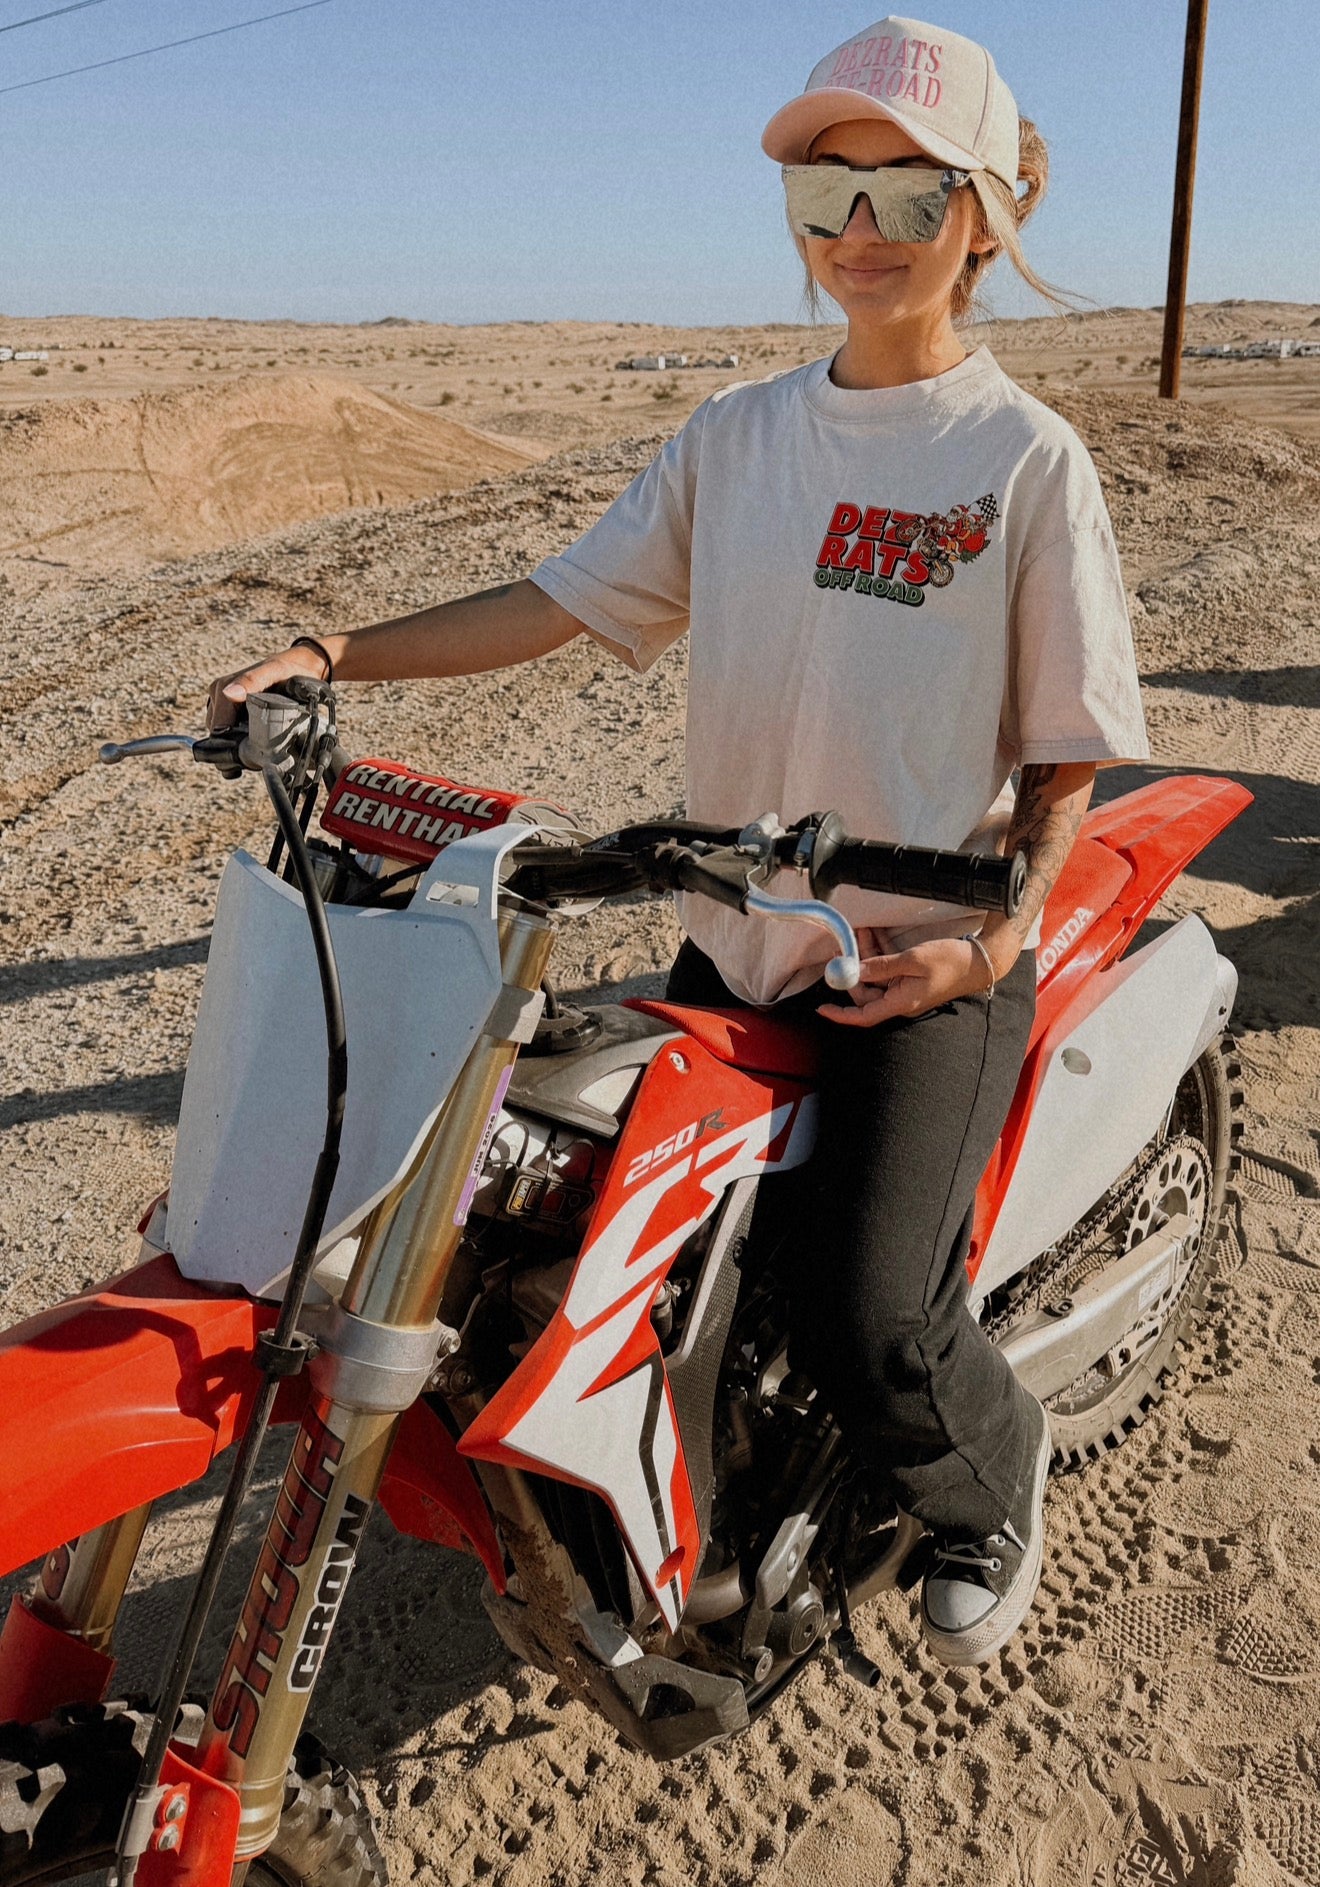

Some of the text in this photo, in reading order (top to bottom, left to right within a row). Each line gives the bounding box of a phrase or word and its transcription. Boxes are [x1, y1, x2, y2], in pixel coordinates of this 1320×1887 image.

[830, 36, 943, 76] DEZRATS
[827, 501, 922, 548] DEZ
[813, 568, 926, 607] OFF ROAD
[816, 533, 932, 587] RATS
[345, 764, 501, 820] RENTHAL
[622, 1106, 730, 1189] 250R
[213, 1406, 346, 1760] SHOWA
[287, 1493, 373, 1693] CROW
